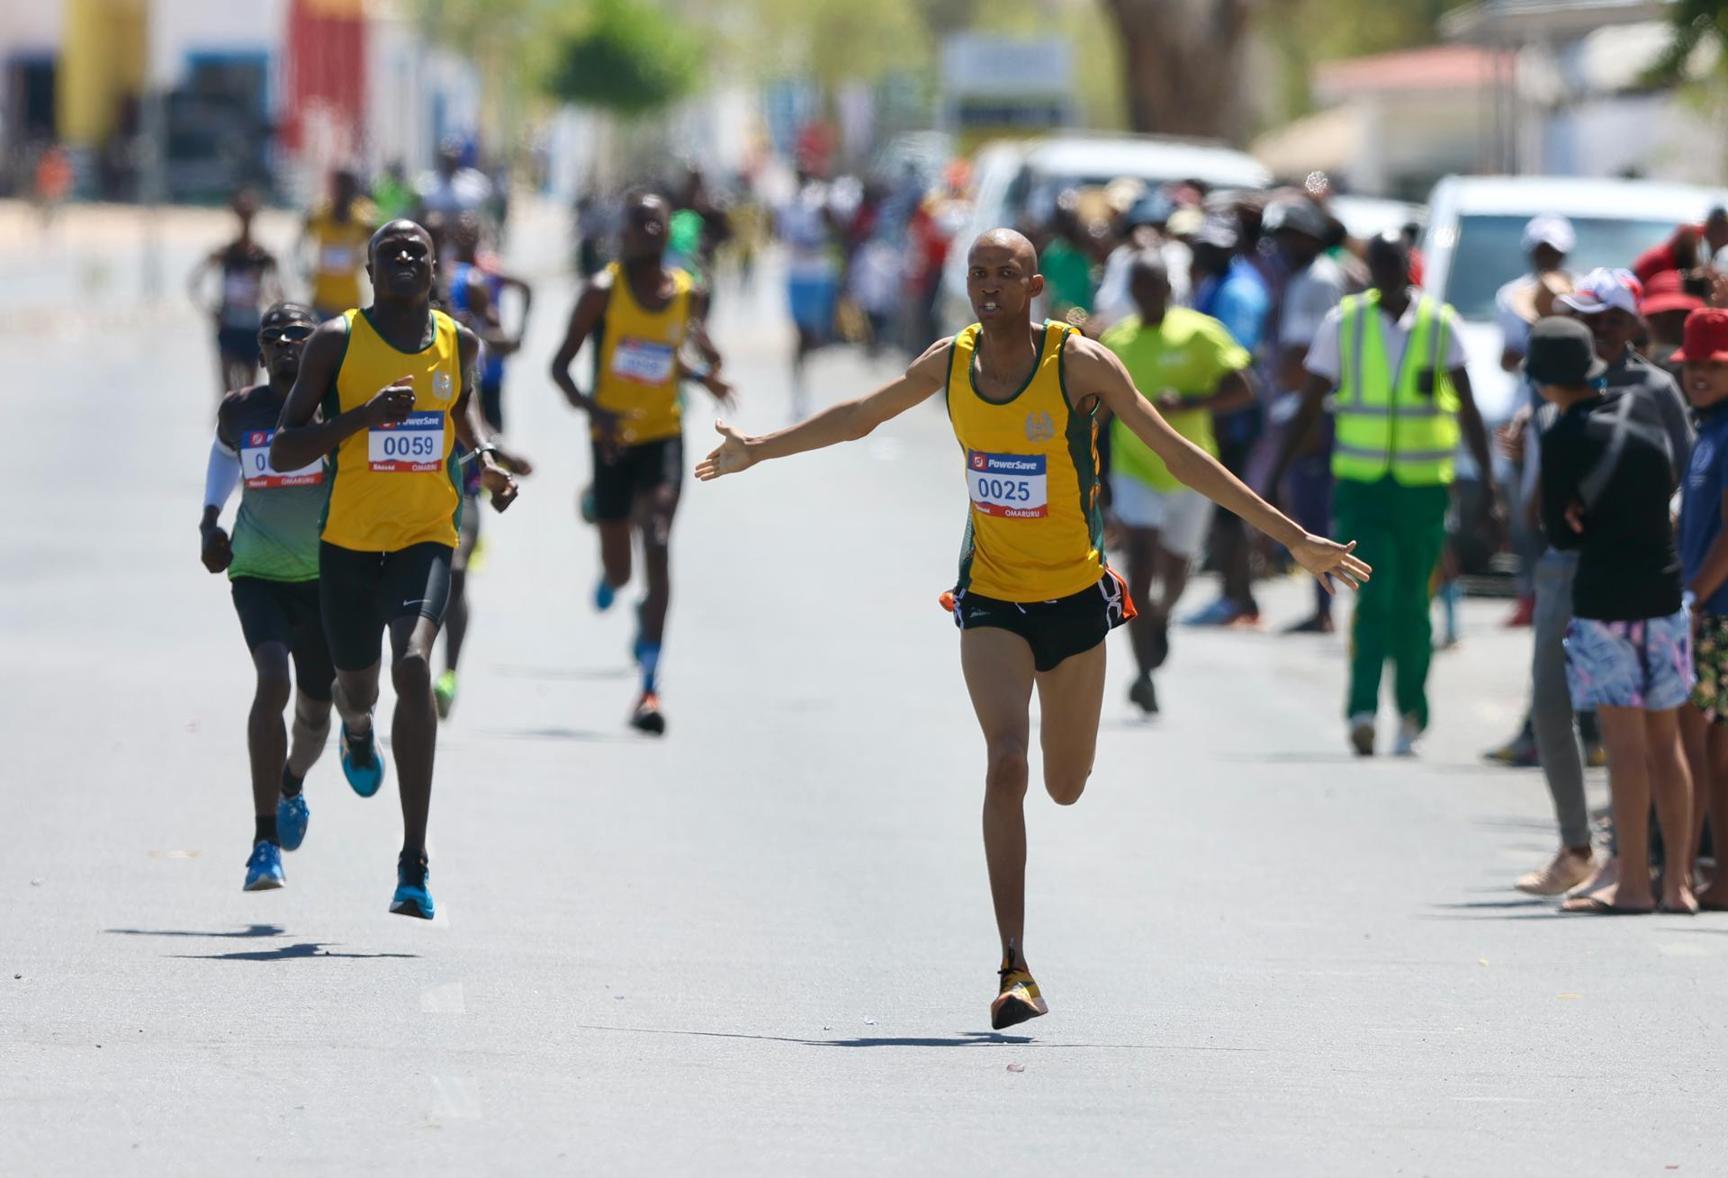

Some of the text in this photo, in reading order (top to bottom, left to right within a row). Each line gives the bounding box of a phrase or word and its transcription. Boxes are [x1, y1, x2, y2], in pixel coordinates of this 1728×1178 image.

[384, 437, 433, 455] 0059
[988, 459, 1037, 470] PowerSave
[978, 478, 1030, 501] 0025
[1004, 509, 1040, 517] OMARURU
